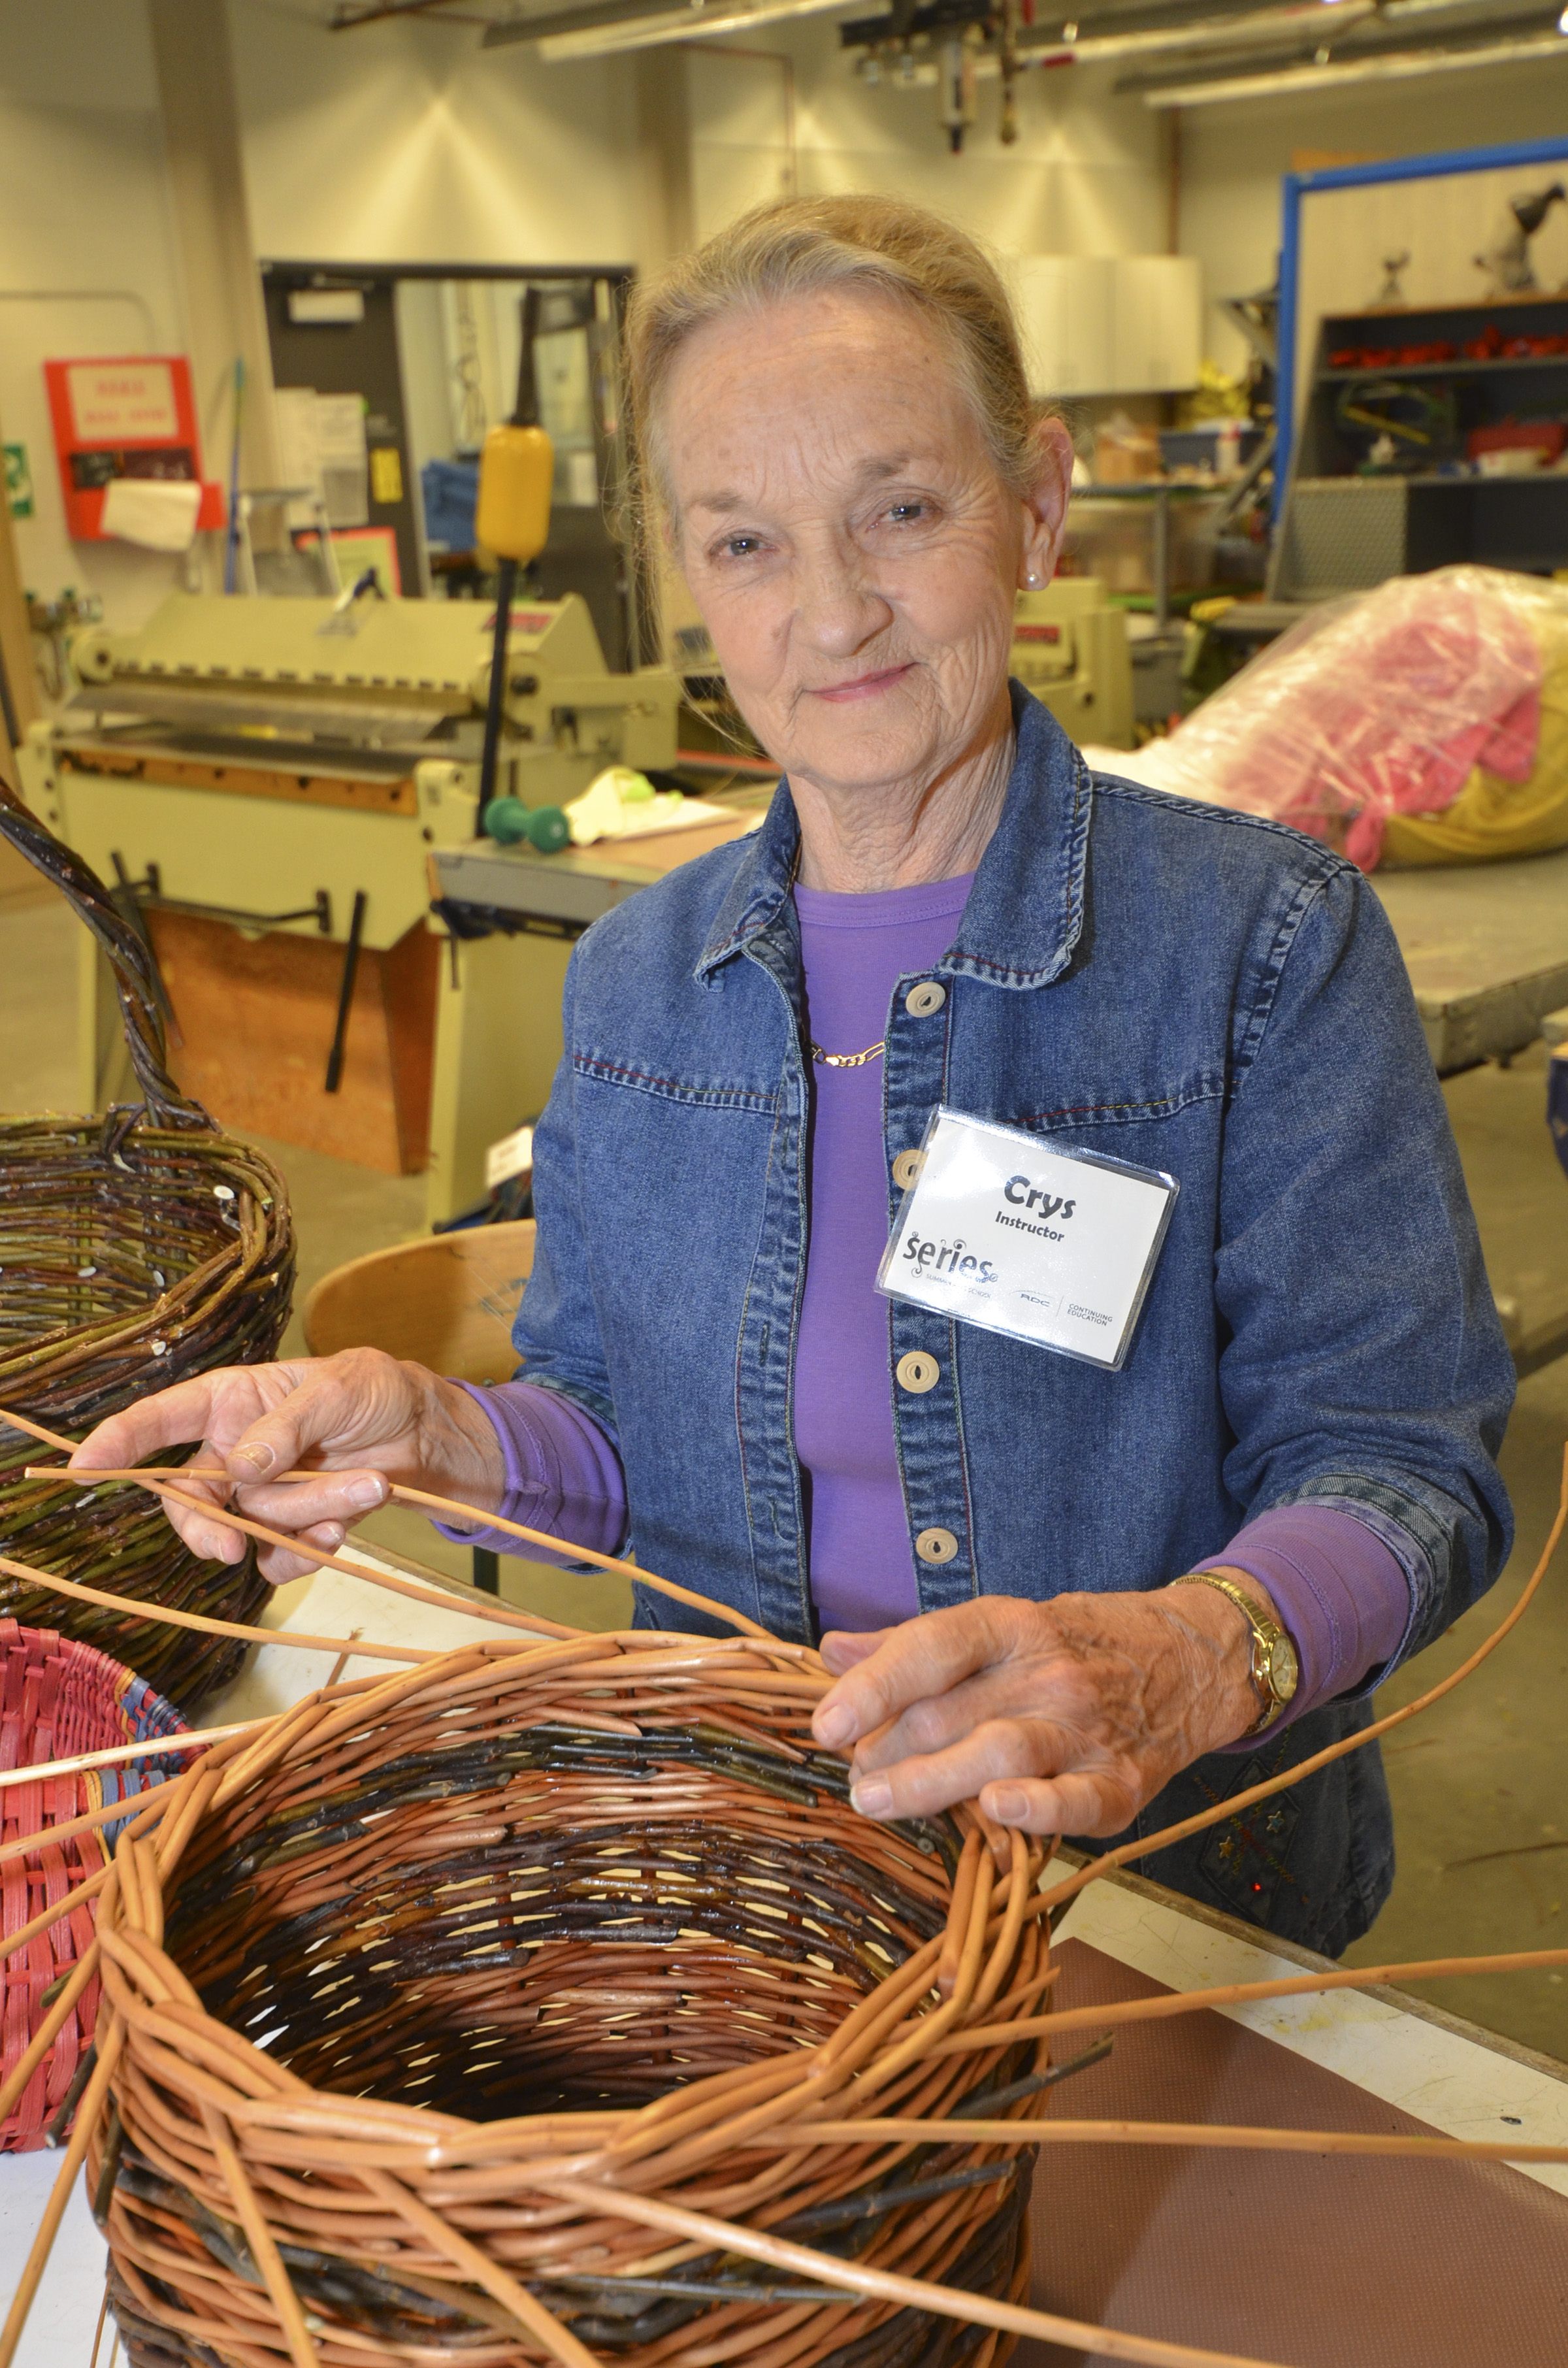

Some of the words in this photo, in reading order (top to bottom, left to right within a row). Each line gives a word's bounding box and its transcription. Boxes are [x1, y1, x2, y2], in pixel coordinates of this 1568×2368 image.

[1004, 1175, 1077, 1219] Crys
[995, 1211, 1065, 1243] Instructor
[903, 1231, 998, 1283] series
[926, 1274, 952, 1286] SUMM
[1020, 1293, 1050, 1307] RDC
[1067, 1309, 1108, 1326] EDUCATION
[1069, 1303, 1113, 1323] CONTINUING
